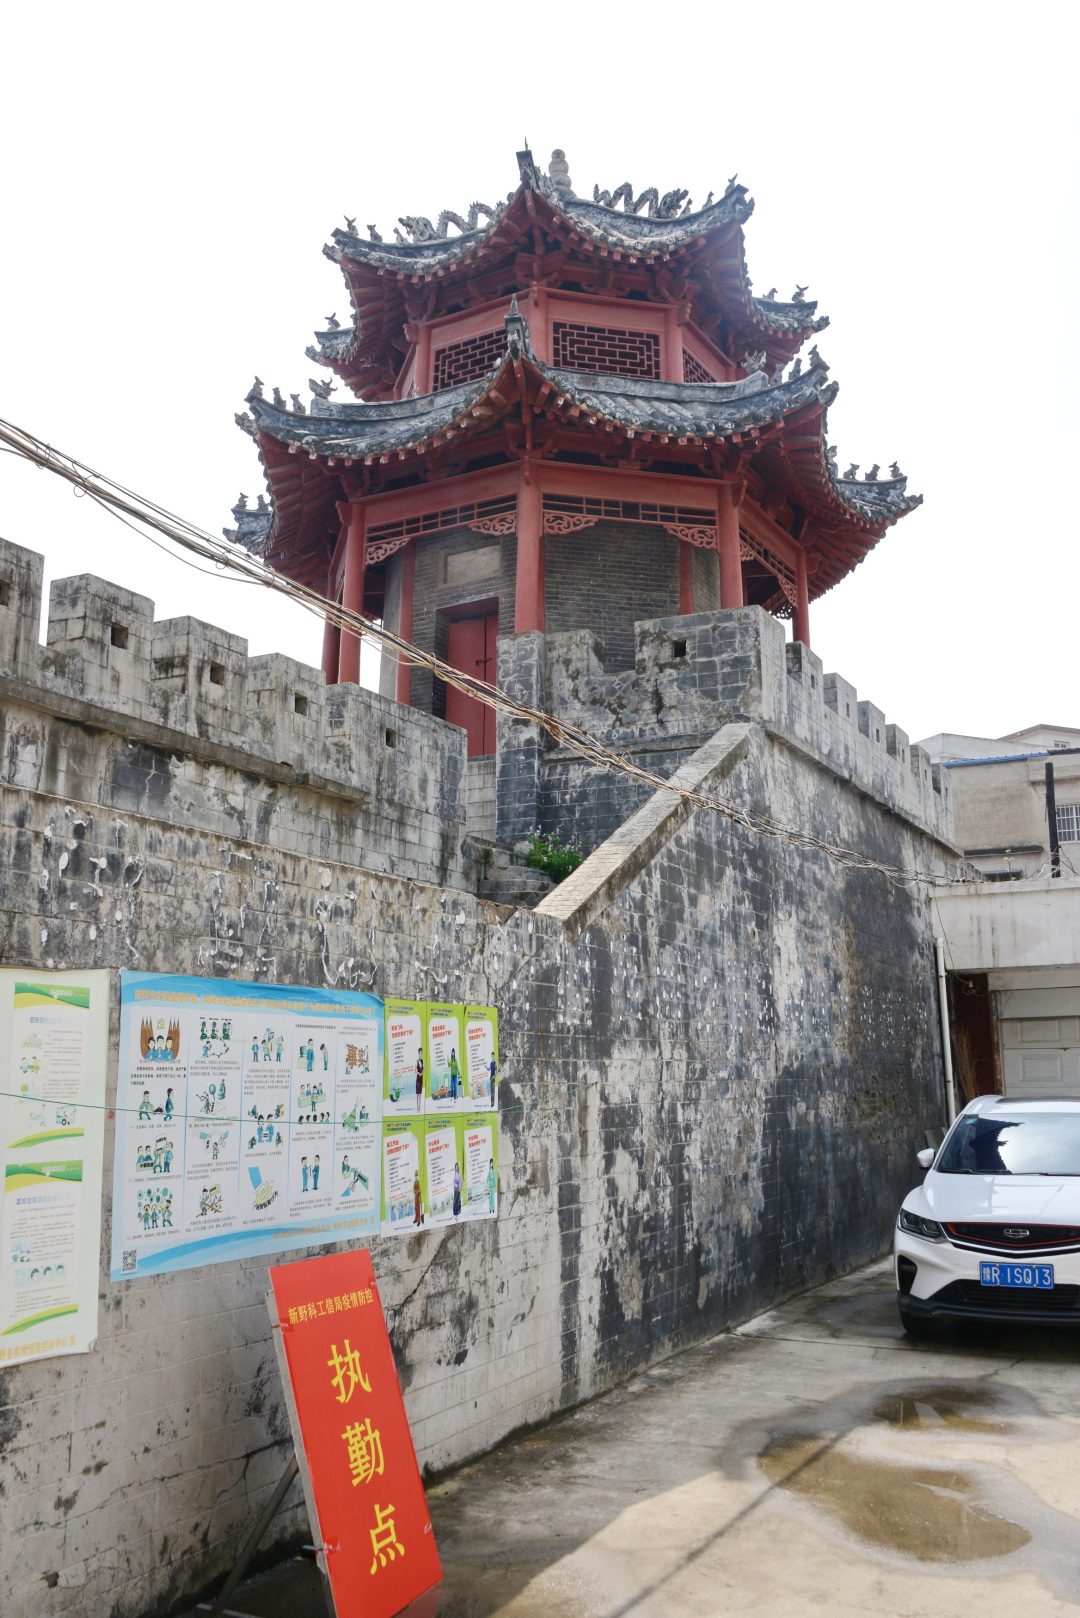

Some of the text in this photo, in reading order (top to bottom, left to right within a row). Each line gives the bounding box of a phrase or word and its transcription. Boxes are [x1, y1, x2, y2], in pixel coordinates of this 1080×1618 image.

[288, 1288, 374, 1324] 新野科工信局疫情防控
